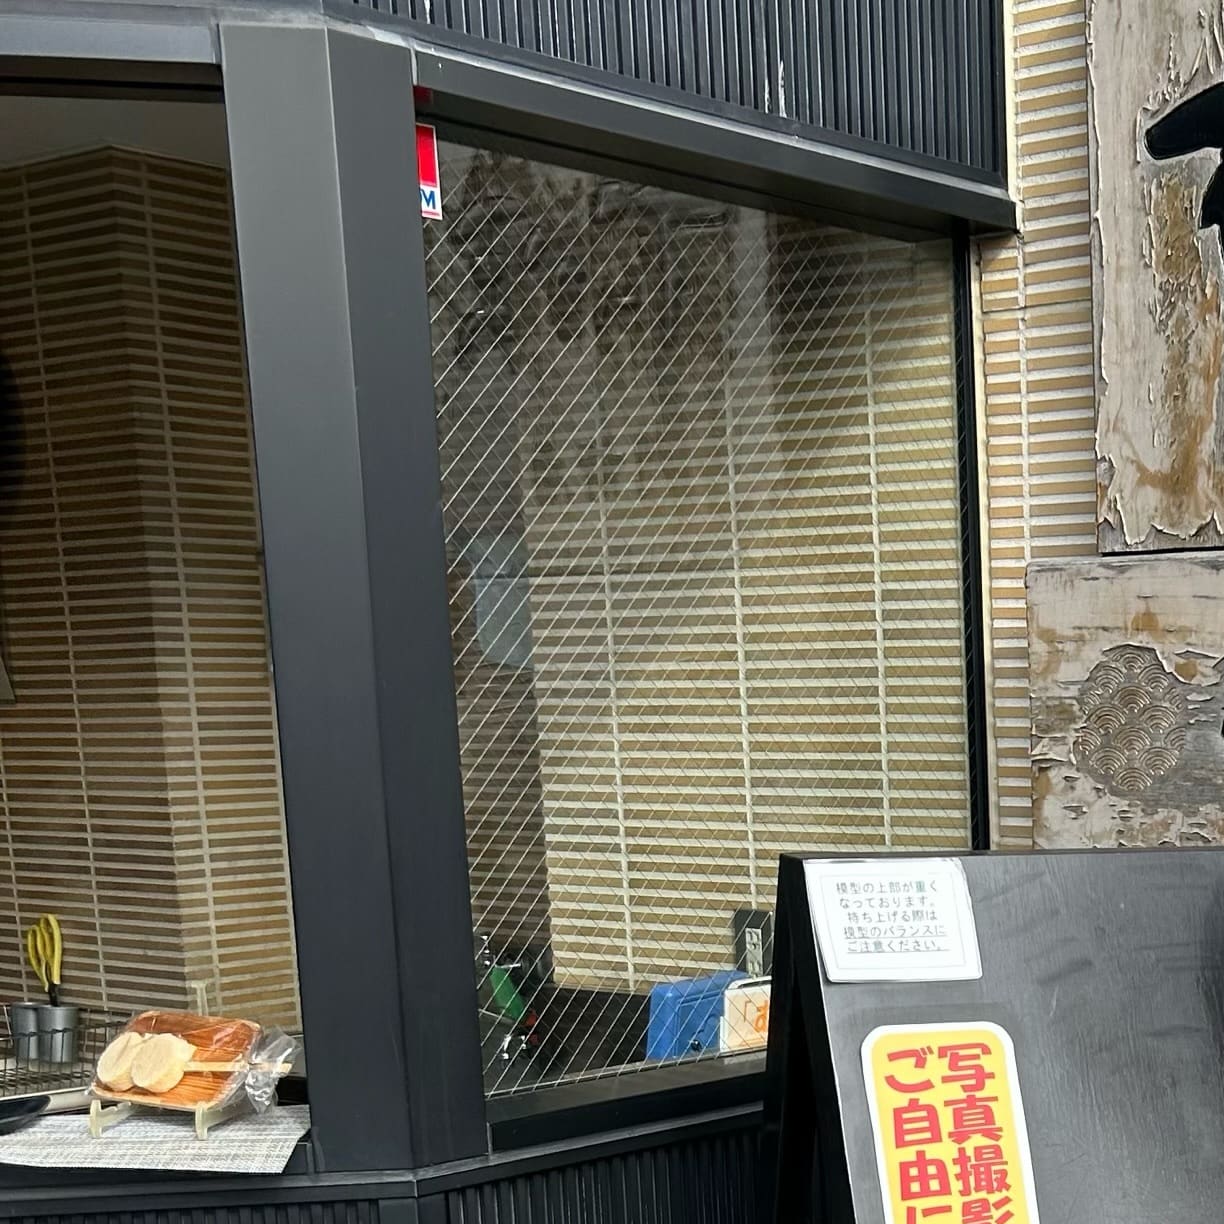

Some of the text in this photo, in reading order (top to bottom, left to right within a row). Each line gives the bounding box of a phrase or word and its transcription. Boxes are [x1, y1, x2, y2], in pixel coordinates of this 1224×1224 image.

[836, 880, 937, 895] 模型の上部が重く
[839, 896, 936, 909] なっております。
[847, 910, 938, 923] 持ち上げる際は
[843, 925, 946, 938] 模型のバランスに
[847, 939, 942, 952] ご注意ください。
